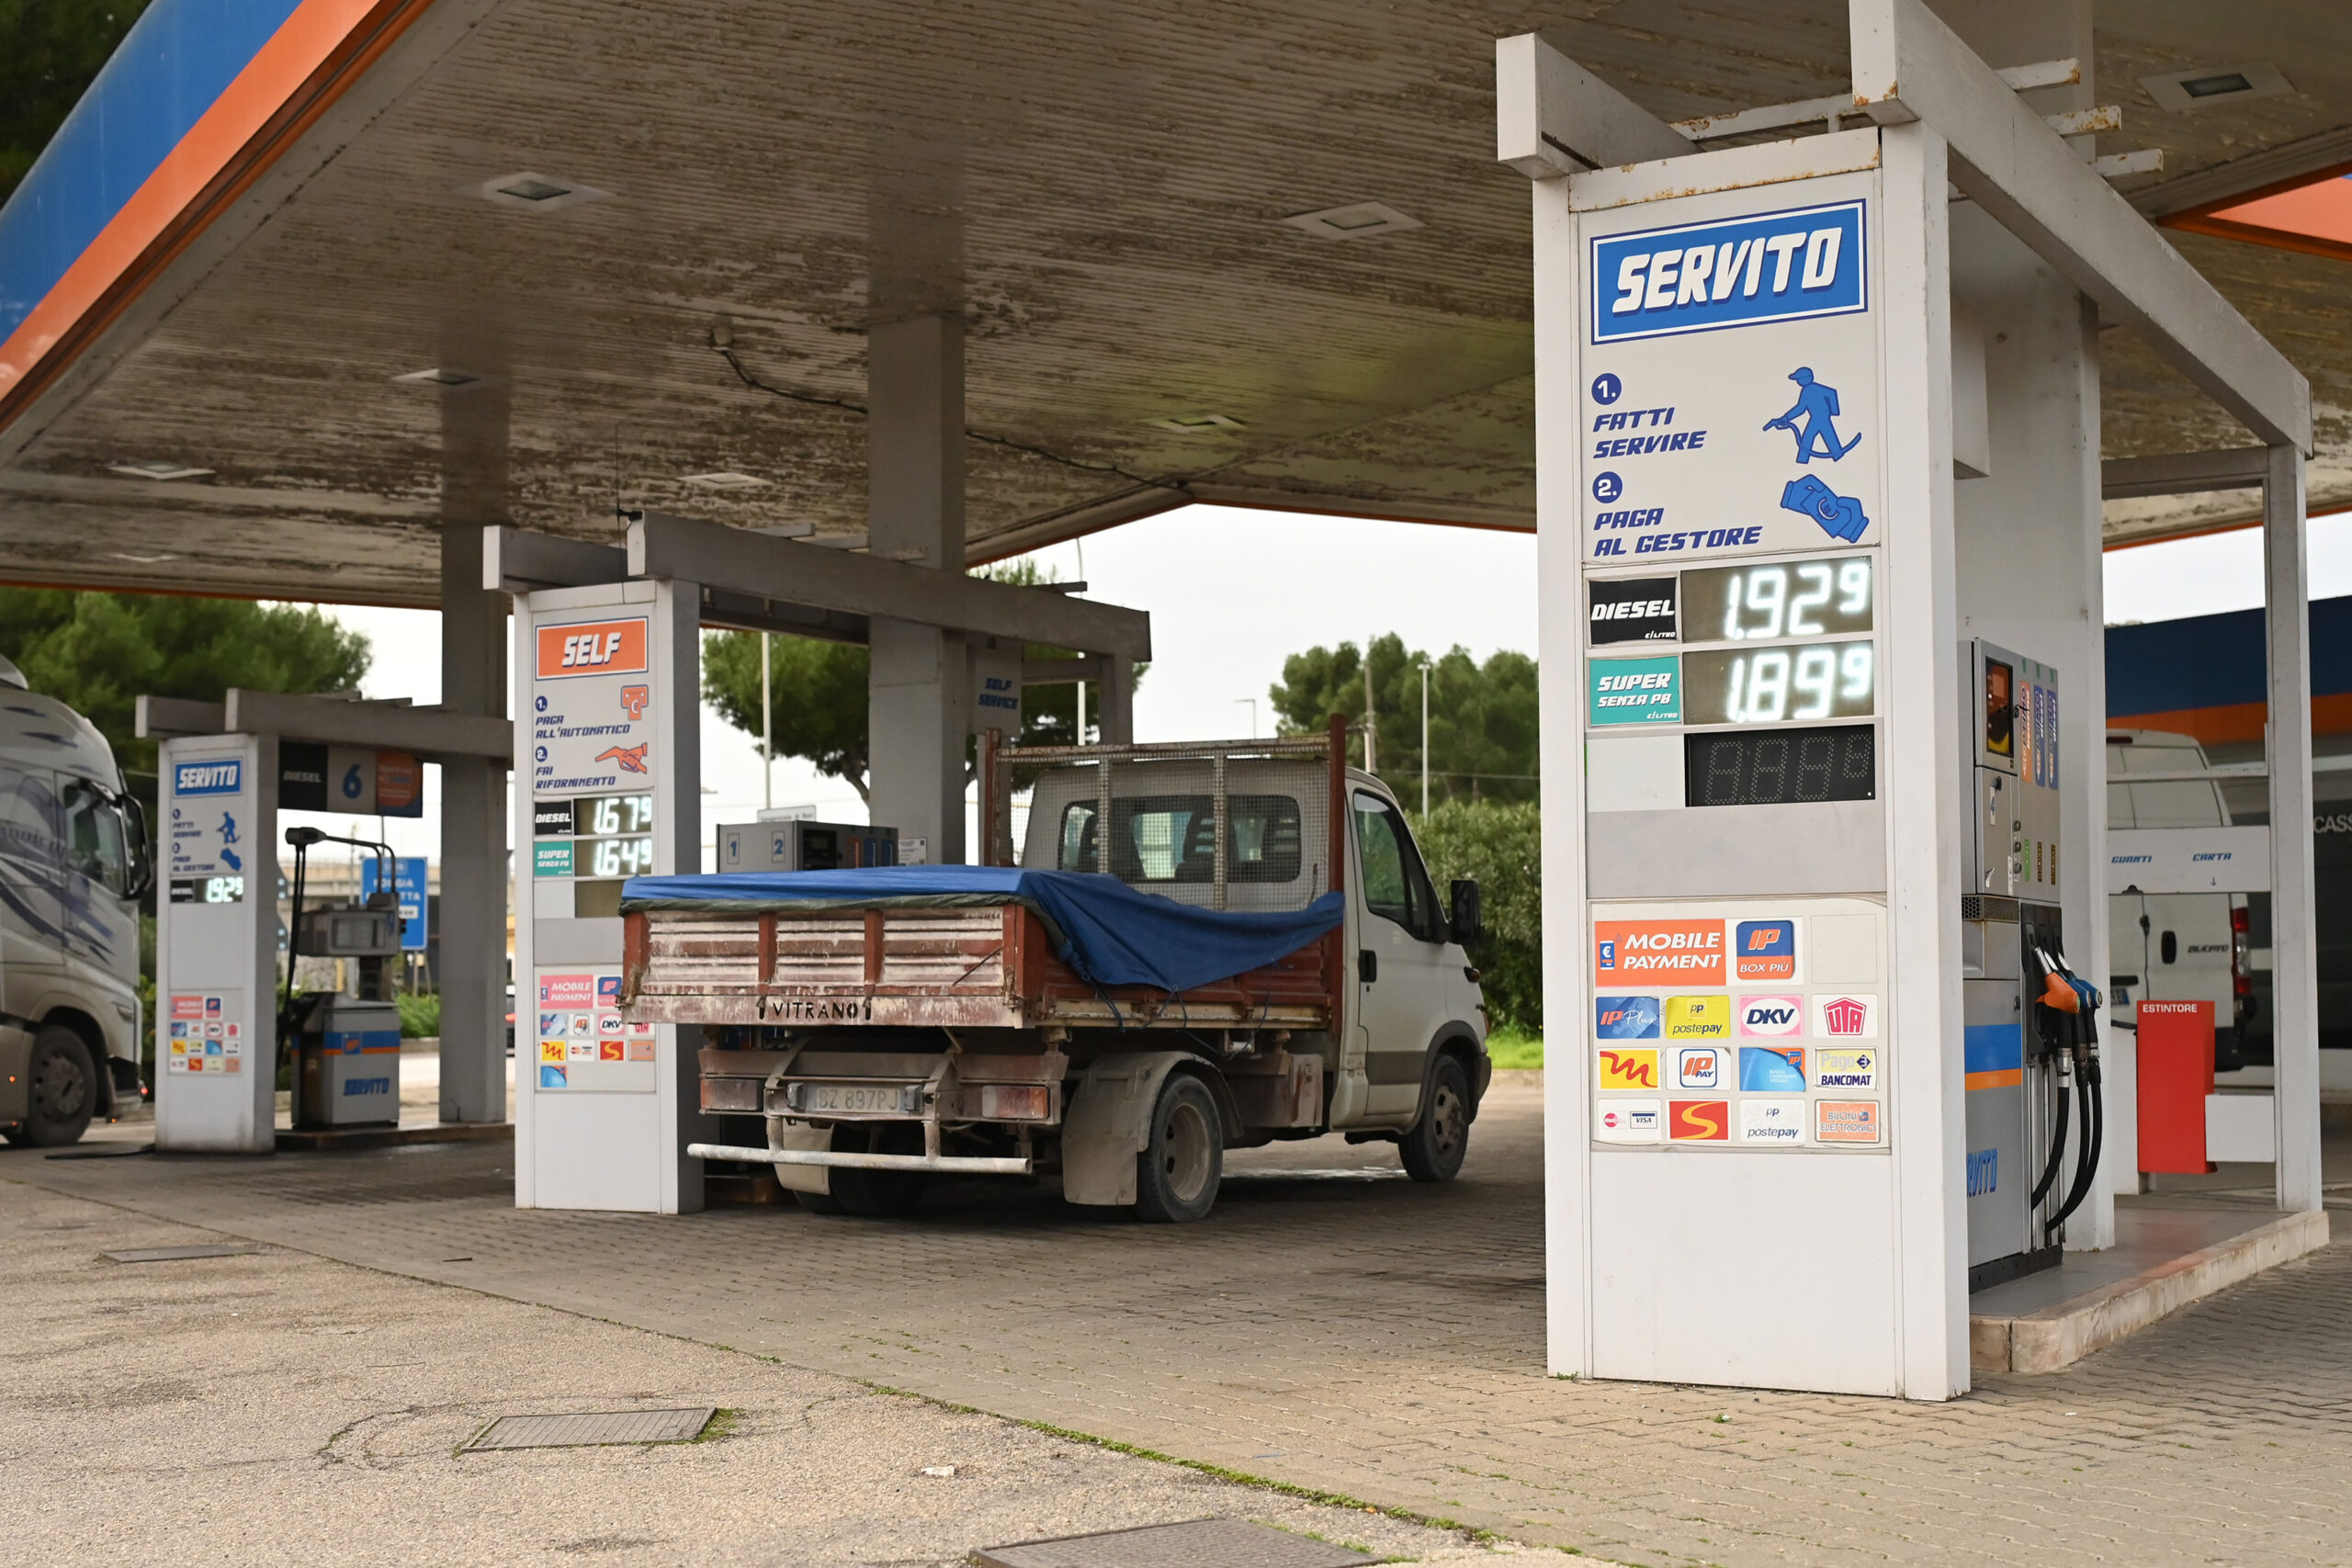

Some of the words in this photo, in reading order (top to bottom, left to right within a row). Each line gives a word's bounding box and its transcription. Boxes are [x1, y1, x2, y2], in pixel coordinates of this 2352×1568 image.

[1611, 226, 1843, 317] SERVITO
[1592, 407, 1675, 433] FATTI
[1592, 431, 1707, 459] SERVIRE
[1593, 507, 1665, 531] PAGA
[1594, 537, 1627, 558] AL
[1634, 525, 1763, 554] GESTORE
[1590, 599, 1676, 621] DIESEL
[561, 631, 622, 669] SELF
[985, 677, 1012, 692] SELF
[1597, 672, 1672, 692] SUPER
[978, 693, 1018, 710] SERVICE
[1597, 694, 1647, 708] SENZA
[1650, 693, 1672, 705] PB
[536, 715, 564, 726] PAGA
[536, 724, 630, 739] ALL'AUTOMATICO
[178, 765, 238, 789] SERVITO
[283, 771, 322, 783] DIESEL
[536, 766, 553, 776] FAI
[343, 763, 362, 799] 6
[536, 776, 616, 790] RIFORNIMENTO
[536, 813, 571, 824] DIESEL
[537, 850, 570, 860] SUPER
[730, 840, 737, 857] 1
[774, 839, 784, 855] 2
[2111, 855, 2153, 863] GUANTI
[2192, 852, 2232, 862] CARTA
[1623, 931, 1721, 951] MOBILE
[1747, 929, 1781, 951] IP
[1623, 953, 1722, 970] PAYMENT
[1740, 964, 1766, 974] BOX
[1770, 960, 1789, 973] PIÙ
[552, 982, 592, 992] MOBILE
[551, 993, 592, 1002] PAYMENT
[772, 1001, 858, 1020] VITRANO
[2143, 1004, 2198, 1013] ESTINTORE
[602, 1020, 622, 1029] DKV
[1600, 1010, 1623, 1025] IP
[1747, 1009, 1794, 1025] DKV
[1672, 1021, 1723, 1035] postepay
[1683, 1057, 1713, 1076] IP
[1821, 1052, 1855, 1070] Pago
[344, 1077, 390, 1096] SERVITO
[1821, 1075, 1871, 1086] BANCOMAT
[819, 1089, 838, 1109] BZ
[1827, 1111, 1858, 1121] BUONI
[1747, 1127, 1799, 1138] postepay
